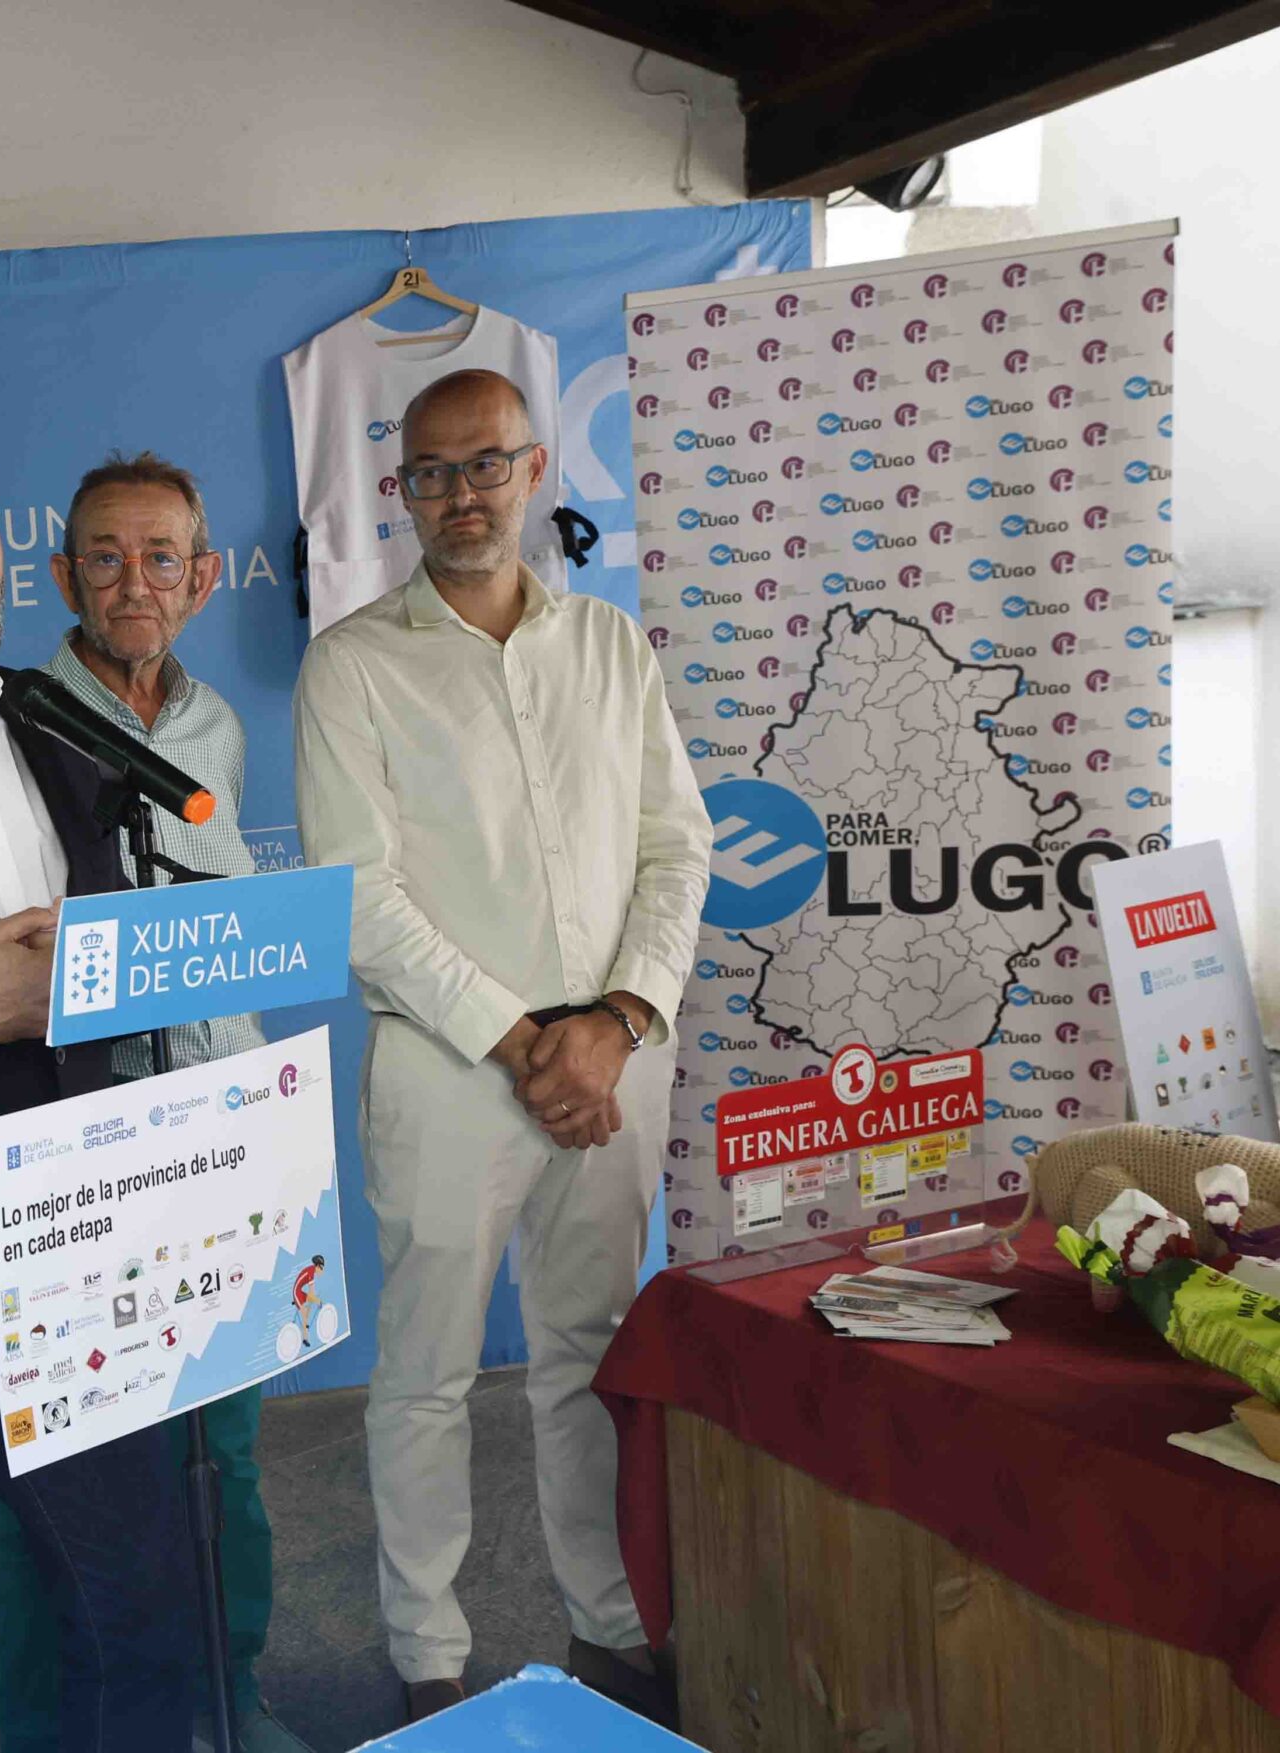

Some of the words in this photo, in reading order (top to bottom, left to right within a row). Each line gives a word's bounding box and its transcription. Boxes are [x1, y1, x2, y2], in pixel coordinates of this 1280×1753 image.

[990, 401, 1033, 415] LUGO
[840, 418, 882, 432] LUGO
[696, 434, 736, 449] LUGO
[1024, 439, 1067, 453] LUGO
[873, 455, 915, 469] LUGO
[728, 472, 768, 485] LUGO
[991, 484, 1035, 497] LUGO
[843, 499, 884, 513] LUGO
[700, 514, 739, 528] LUGO
[1026, 521, 1069, 536] LUGO
[875, 535, 917, 549] LUGO
[731, 551, 771, 563] LUGO
[993, 566, 1036, 579] LUGO
[845, 579, 886, 592] LUGO
[704, 592, 742, 606] LUGO
[1026, 603, 1070, 616] LUGO
[735, 629, 773, 641] LUGO
[994, 646, 1037, 659] LUGO
[706, 670, 745, 682] LUGO
[1028, 683, 1071, 696] LUGO
[737, 705, 776, 717] LUGO
[995, 725, 1038, 738] LUGO
[709, 745, 747, 757] LUGO
[1028, 763, 1071, 775] LUGO
[827, 812, 889, 830] PARA
[827, 828, 920, 848] COMER,
[827, 840, 1130, 917] LUGO
[1134, 910, 1157, 940] LA
[1152, 898, 1209, 935] VUELTA
[132, 912, 242, 956] XUNTA
[129, 961, 171, 997] DE
[182, 941, 308, 988] GALICIA
[717, 968, 755, 978] LUGO
[1032, 994, 1074, 1006] LUGO
[720, 1040, 757, 1051] LUGO
[1000, 1033, 1041, 1044] LUGO
[1032, 1070, 1074, 1081] LUGO
[242, 1088, 270, 1106] LUGO
[167, 1096, 209, 1113] Xacobeo
[723, 1112, 746, 1125] Zona
[748, 1105, 791, 1120] exclusiva
[792, 1100, 817, 1113] para:
[1002, 1108, 1043, 1119] LUGO
[83, 1117, 124, 1137] GALICIA
[169, 1113, 189, 1127] 2027
[723, 1116, 849, 1165] TERNERA
[857, 1091, 979, 1138] GALLEGA
[24, 1137, 54, 1153] XUNTA
[24, 1153, 36, 1163] DE
[38, 1143, 73, 1160] GALICIA
[1, 1206, 22, 1229] Lo
[27, 1192, 72, 1222] mejor
[76, 1184, 95, 1206] de
[99, 1178, 113, 1200] la
[117, 1160, 187, 1201] provincia
[191, 1152, 208, 1176] de
[211, 1144, 246, 1170] Lugo
[3, 1241, 22, 1262] en
[28, 1228, 66, 1255] cada
[70, 1215, 113, 1243] etapa
